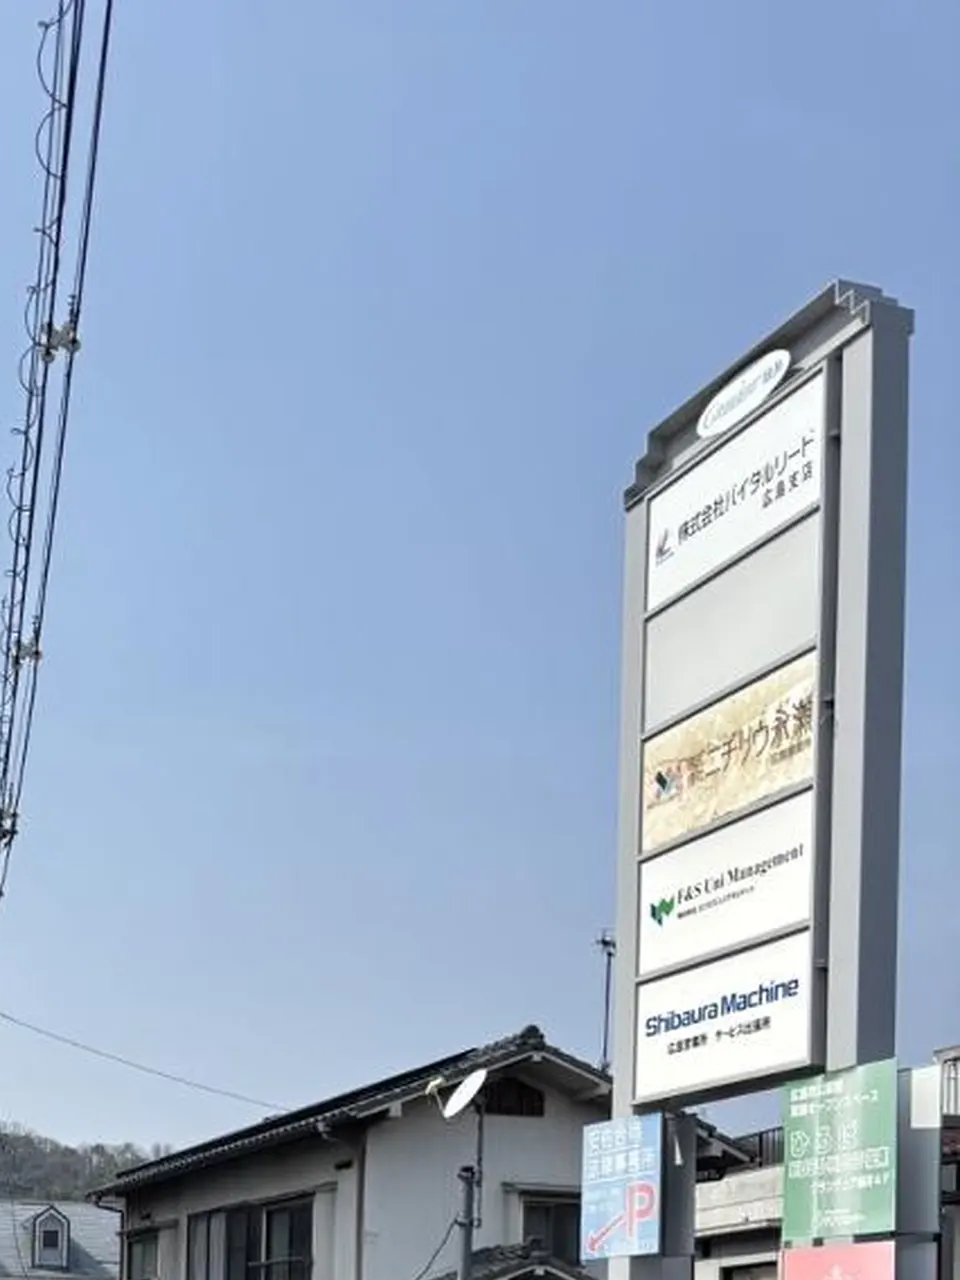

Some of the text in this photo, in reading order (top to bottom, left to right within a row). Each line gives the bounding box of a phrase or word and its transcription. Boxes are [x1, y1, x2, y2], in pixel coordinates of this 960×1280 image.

[727, 843, 804, 883] Management
[645, 979, 800, 1037] Shibaura Machine
[627, 1182, 655, 1238] P
